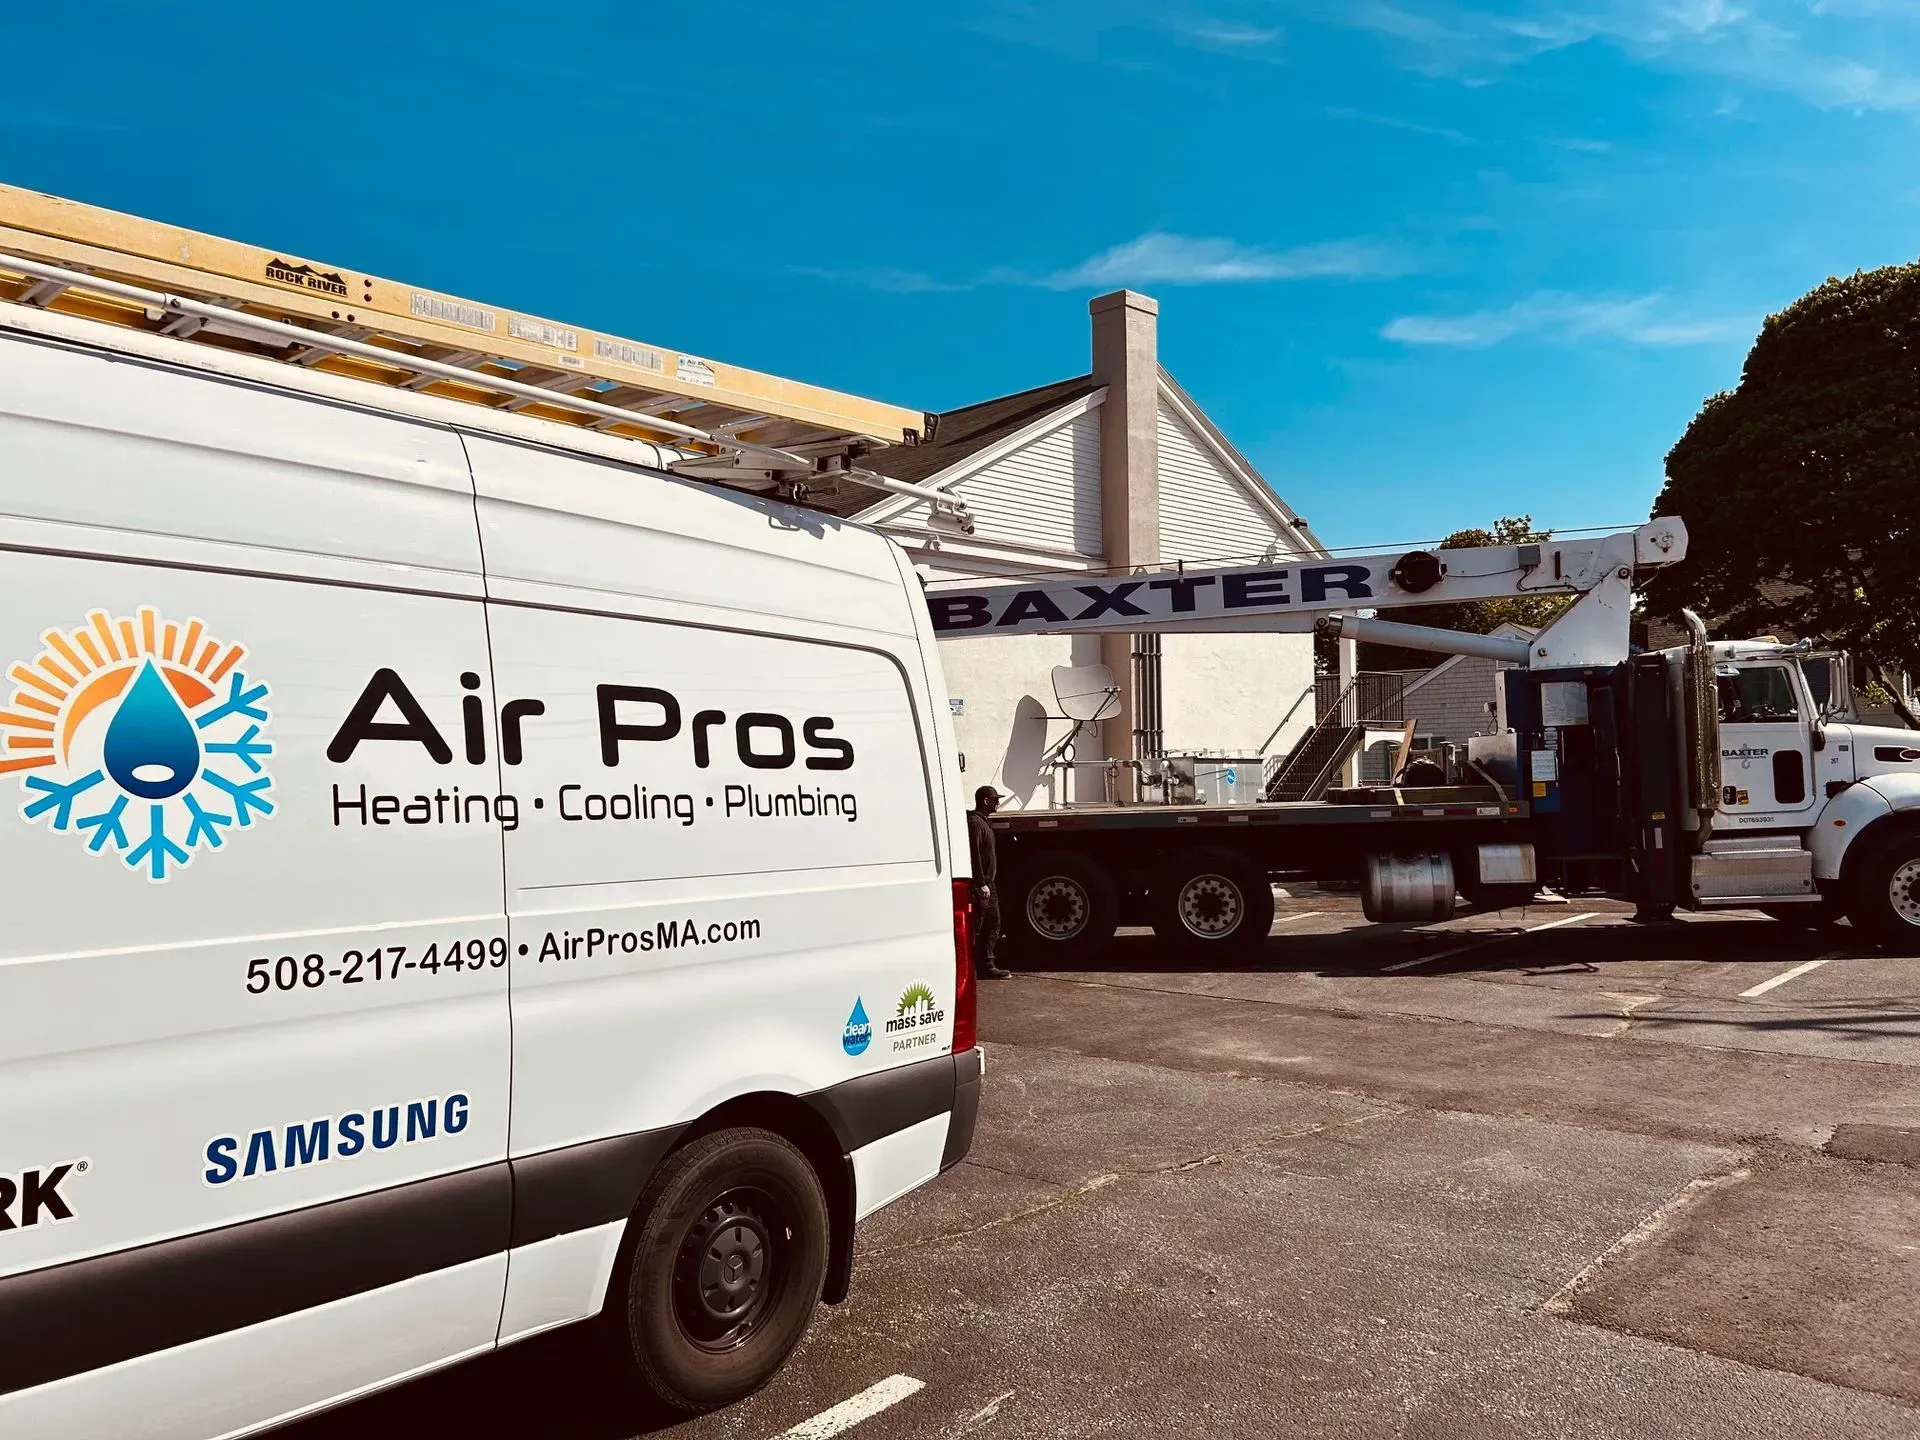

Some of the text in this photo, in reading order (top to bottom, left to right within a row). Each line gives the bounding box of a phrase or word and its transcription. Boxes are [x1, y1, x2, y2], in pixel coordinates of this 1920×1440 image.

[265, 266, 347, 295] ROCK RIVER
[926, 565, 1372, 630] BAXTER
[327, 668, 855, 770] Air Pros
[1722, 748, 1768, 756] BAXTER
[333, 784, 857, 831] Heating Cooling Plumbing
[246, 919, 761, 993] 508-217-4499 AirProsMA.com
[844, 1022, 871, 1036] clean
[885, 1010, 944, 1033] mass save
[845, 1033, 870, 1045] water
[893, 1033, 936, 1052] PARTNER
[205, 1094, 469, 1184] SAMSUNG
